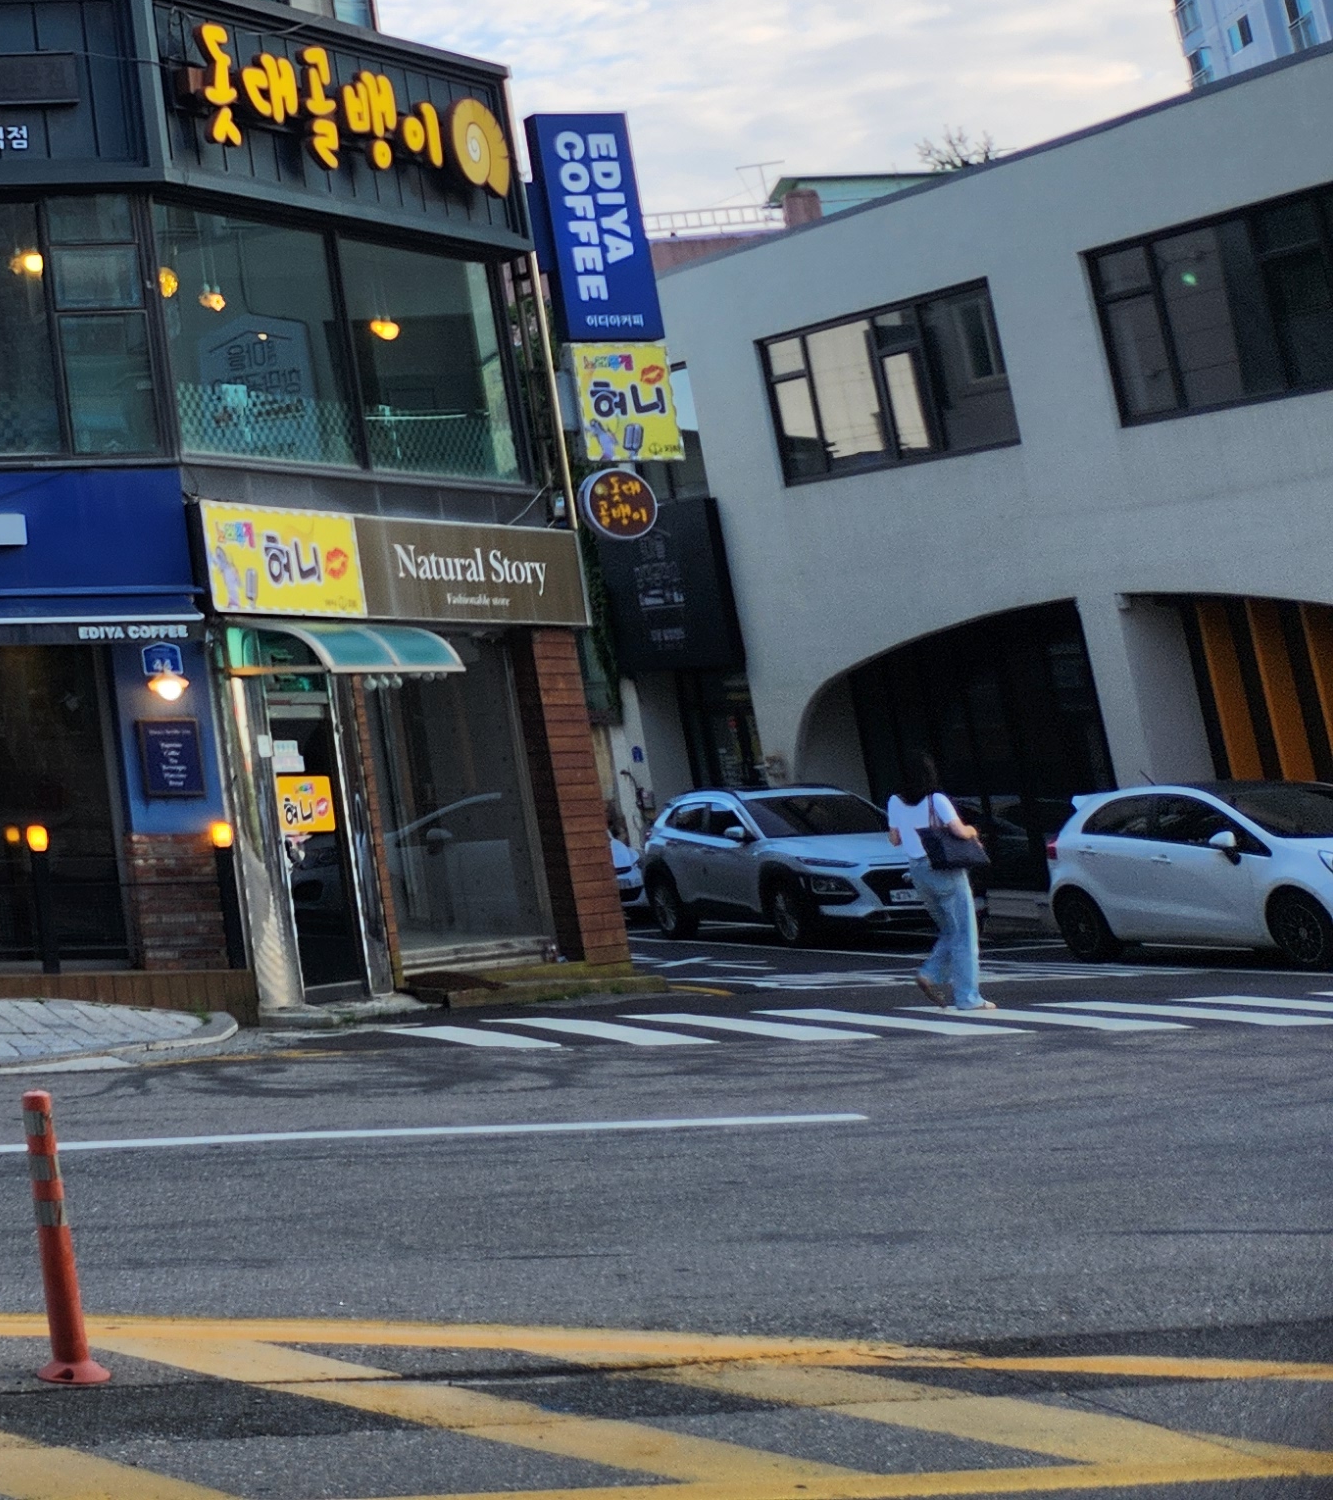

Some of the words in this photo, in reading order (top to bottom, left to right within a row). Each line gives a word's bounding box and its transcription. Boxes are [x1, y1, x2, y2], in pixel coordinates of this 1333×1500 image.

[555, 131, 609, 301] COFFEE
[587, 132, 634, 264] EDIYA
[586, 313, 644, 327] 이디야커피
[590, 381, 666, 418] 허니
[599, 501, 648, 527] 골뱅이
[264, 534, 322, 584] 허니
[392, 543, 486, 582] Natural
[489, 549, 547, 596] Story
[78, 626, 124, 639] EDIYA
[127, 625, 188, 639] COFFEE
[284, 798, 314, 825] 허니
